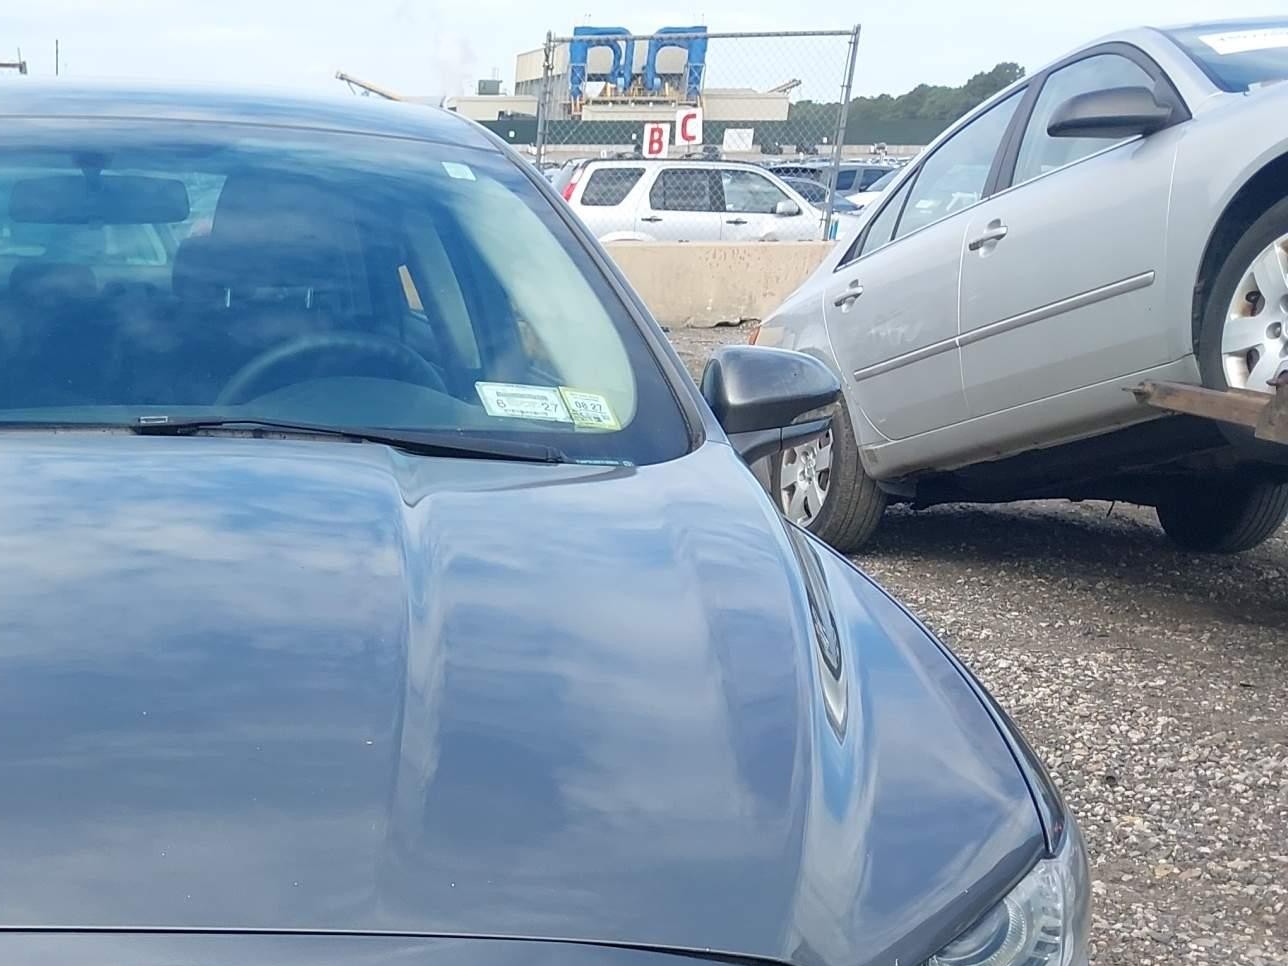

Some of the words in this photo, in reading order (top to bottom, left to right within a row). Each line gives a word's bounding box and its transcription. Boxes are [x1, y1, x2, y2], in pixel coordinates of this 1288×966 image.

[647, 127, 664, 155] B
[681, 113, 697, 142] C
[540, 401, 559, 413] 27
